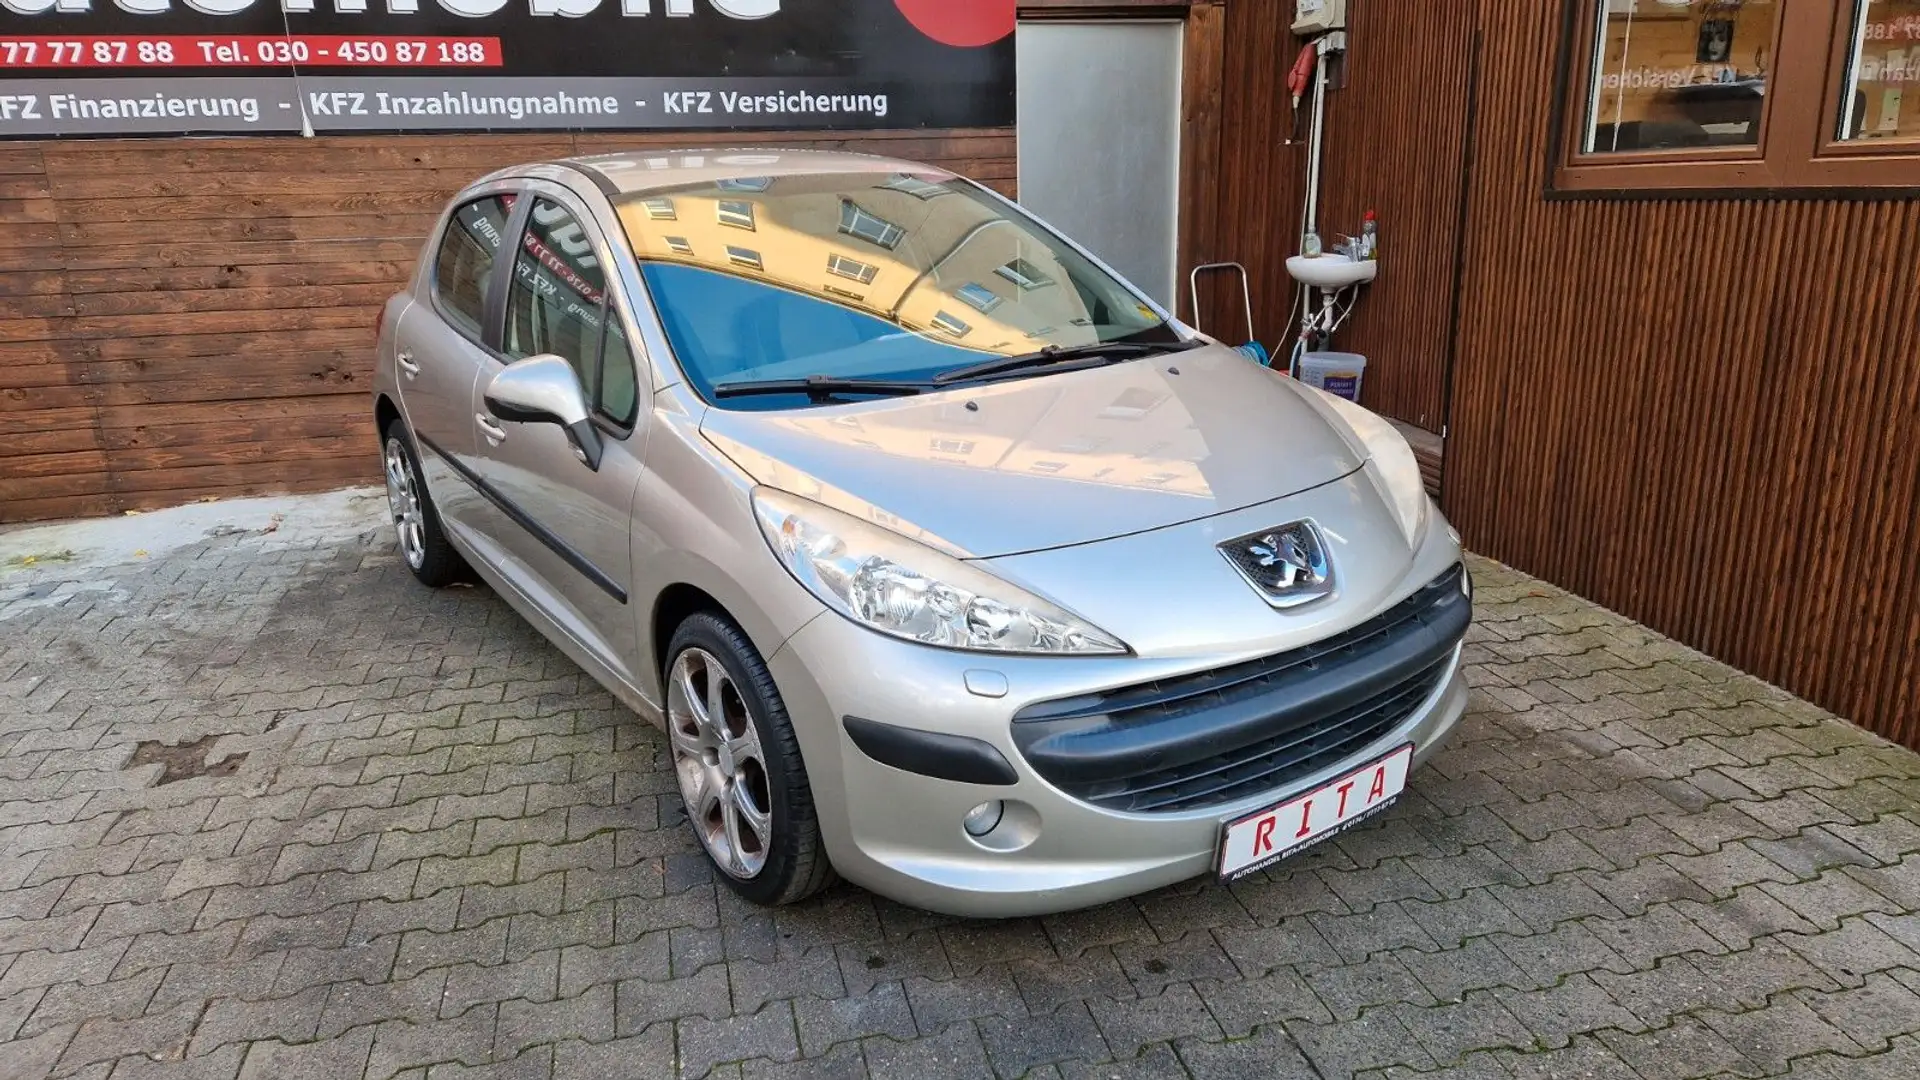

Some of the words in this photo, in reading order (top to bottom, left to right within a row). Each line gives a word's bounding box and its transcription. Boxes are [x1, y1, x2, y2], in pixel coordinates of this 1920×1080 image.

[2, 42, 37, 63] 77
[47, 42, 83, 63] 77
[93, 41, 128, 63] 87
[138, 41, 175, 63] 88
[198, 41, 249, 63] Tel.
[257, 41, 309, 63] 030
[337, 42, 388, 63] 450
[395, 42, 427, 63] 87
[438, 42, 485, 63] 188
[49, 93, 260, 122] Finanzierung
[310, 91, 369, 116] KFZ
[376, 90, 619, 120] Inzahlungnahme
[663, 91, 713, 113] KFZ
[719, 90, 887, 116] Versicherung
